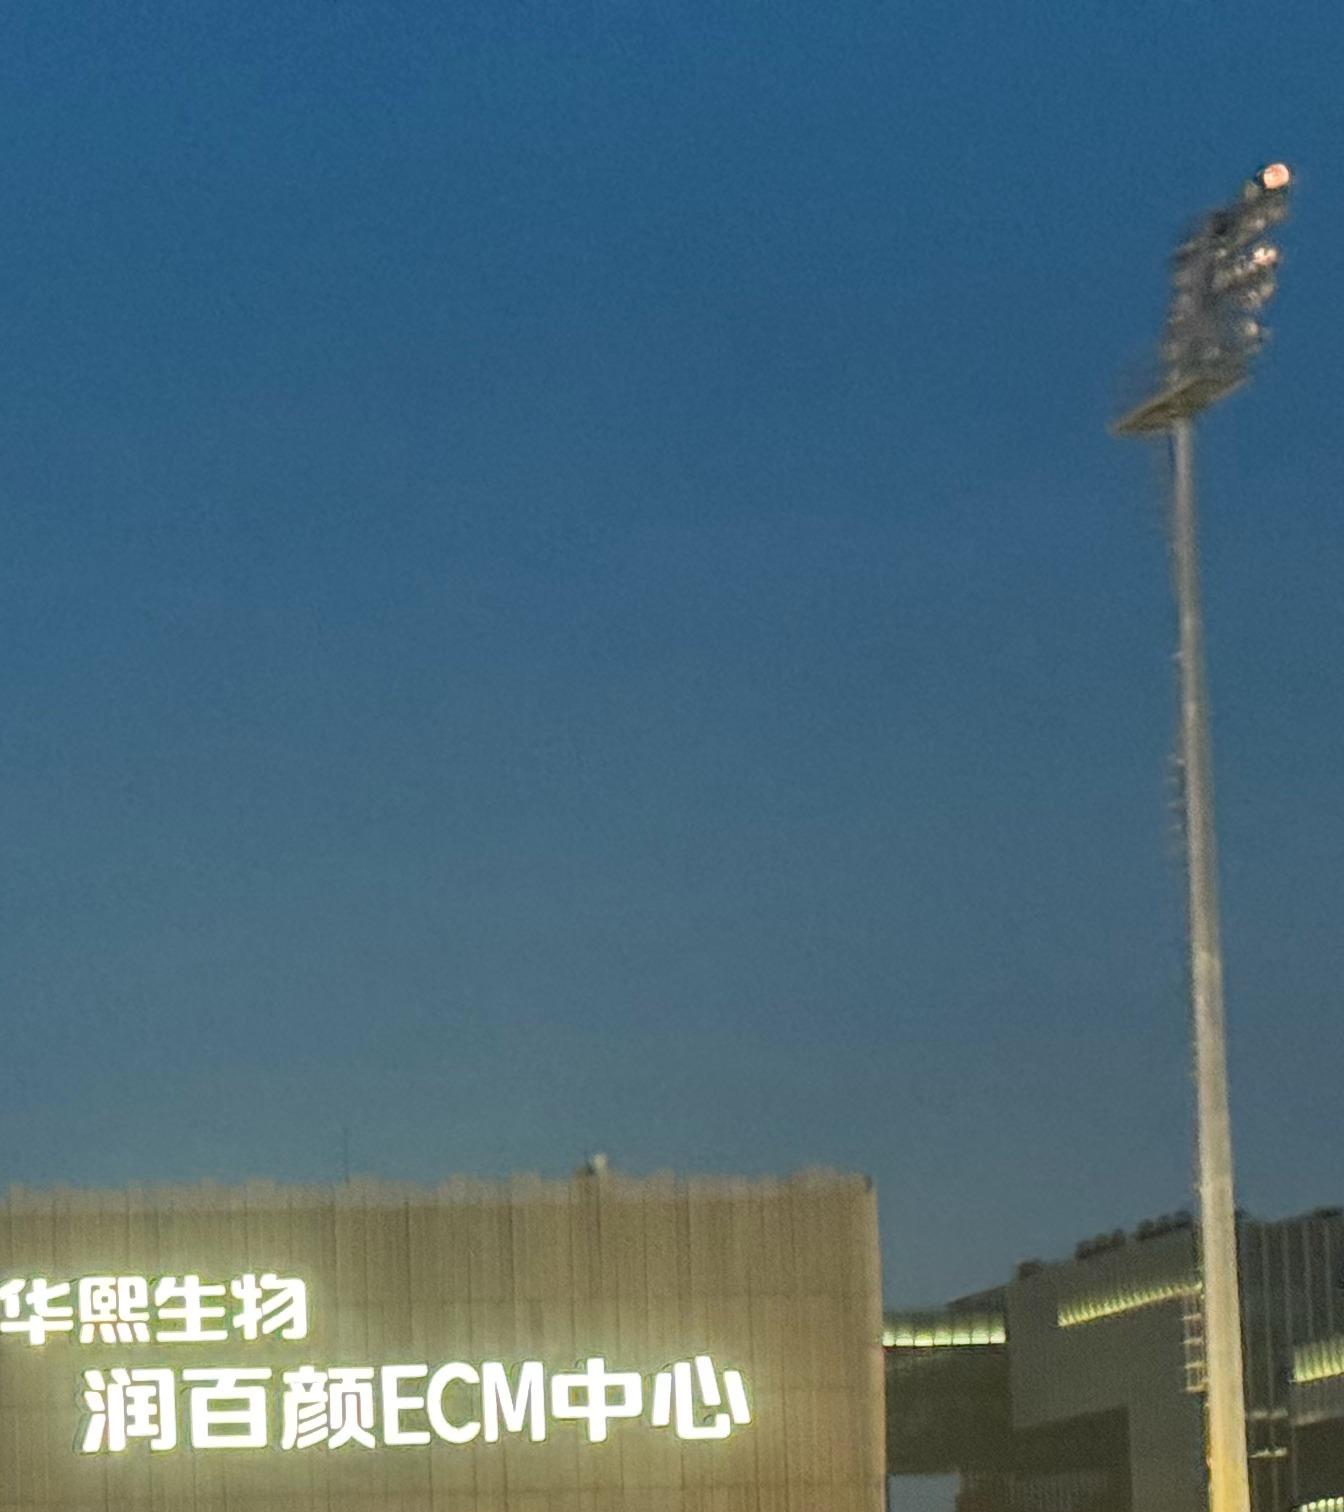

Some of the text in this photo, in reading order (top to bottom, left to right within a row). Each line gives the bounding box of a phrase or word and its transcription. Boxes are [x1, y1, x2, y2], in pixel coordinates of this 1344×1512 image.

[82, 1355, 751, 1453] 润百颜ECM中心
